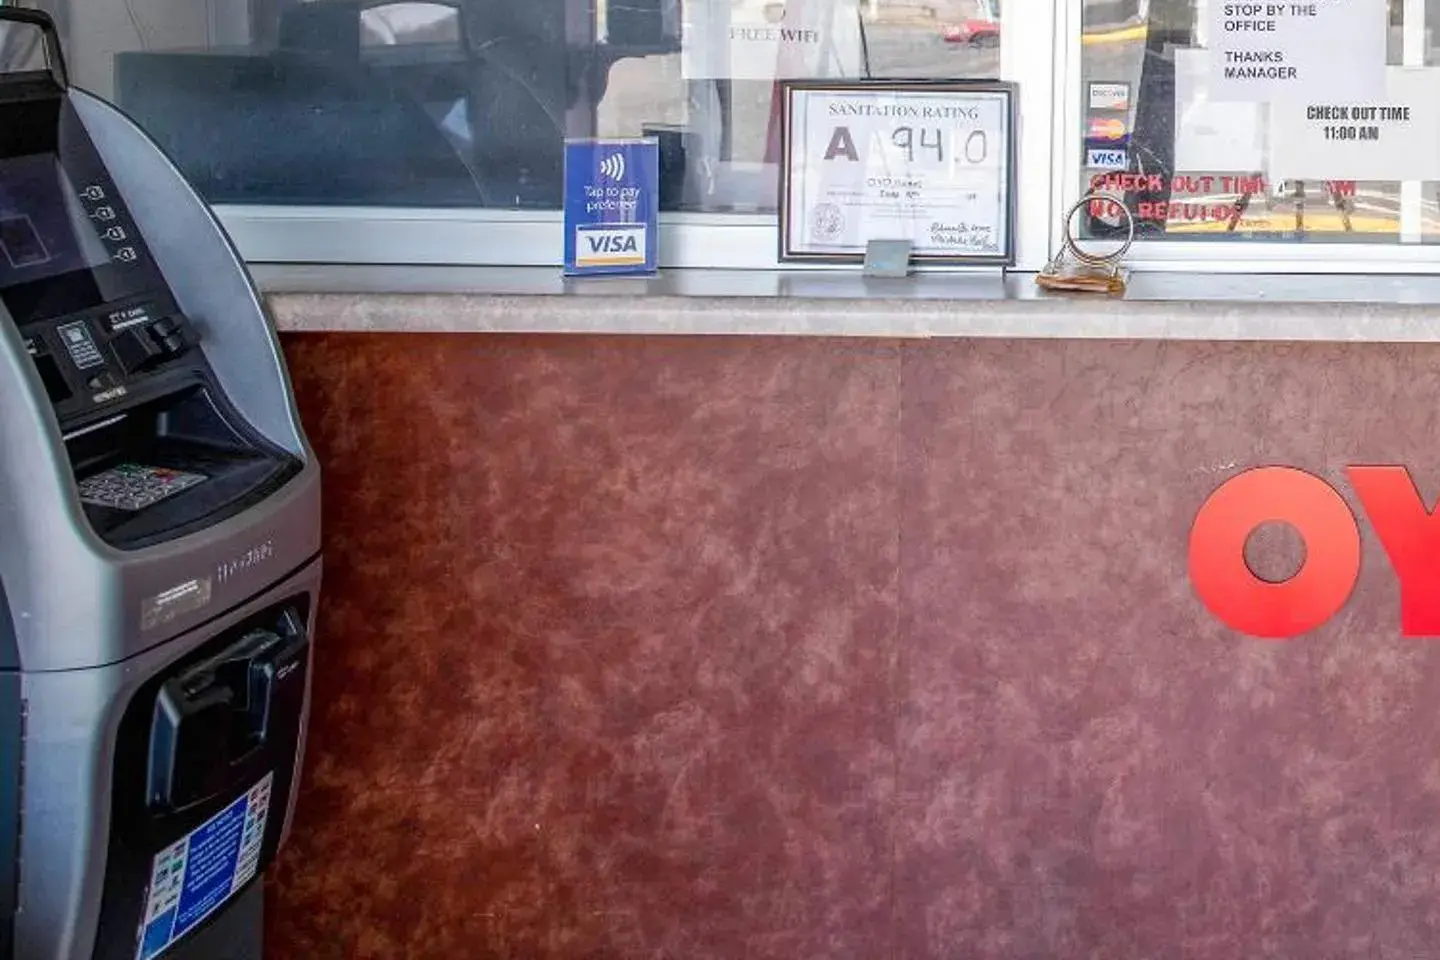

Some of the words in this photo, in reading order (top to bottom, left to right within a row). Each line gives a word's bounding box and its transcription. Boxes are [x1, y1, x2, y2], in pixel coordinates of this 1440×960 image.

[1225, 4, 1262, 16] STOP
[1267, 5, 1285, 16] BY
[1291, 4, 1316, 16] THE
[1225, 21, 1275, 31] OFFICE
[731, 27, 775, 43] FREE
[780, 27, 818, 43] WIFI
[1225, 51, 1283, 63] THANKS
[1225, 67, 1296, 79] MANAGER
[829, 104, 918, 119] SANITATION
[923, 104, 978, 119] RATING
[1307, 106, 1348, 120] CHECK
[1352, 107, 1377, 121] OUT
[1379, 107, 1409, 120] TIME
[1324, 126, 1356, 140] 11:00
[1359, 126, 1378, 140] AM
[824, 127, 859, 163] A
[1092, 153, 1124, 165] VISA
[1090, 174, 1161, 191] CHECK
[1171, 174, 1214, 191] OUT
[584, 186, 603, 198] Tap
[607, 186, 618, 198] to
[621, 186, 640, 198] pay
[1089, 199, 1119, 219] NO
[586, 236, 637, 252] VISA
